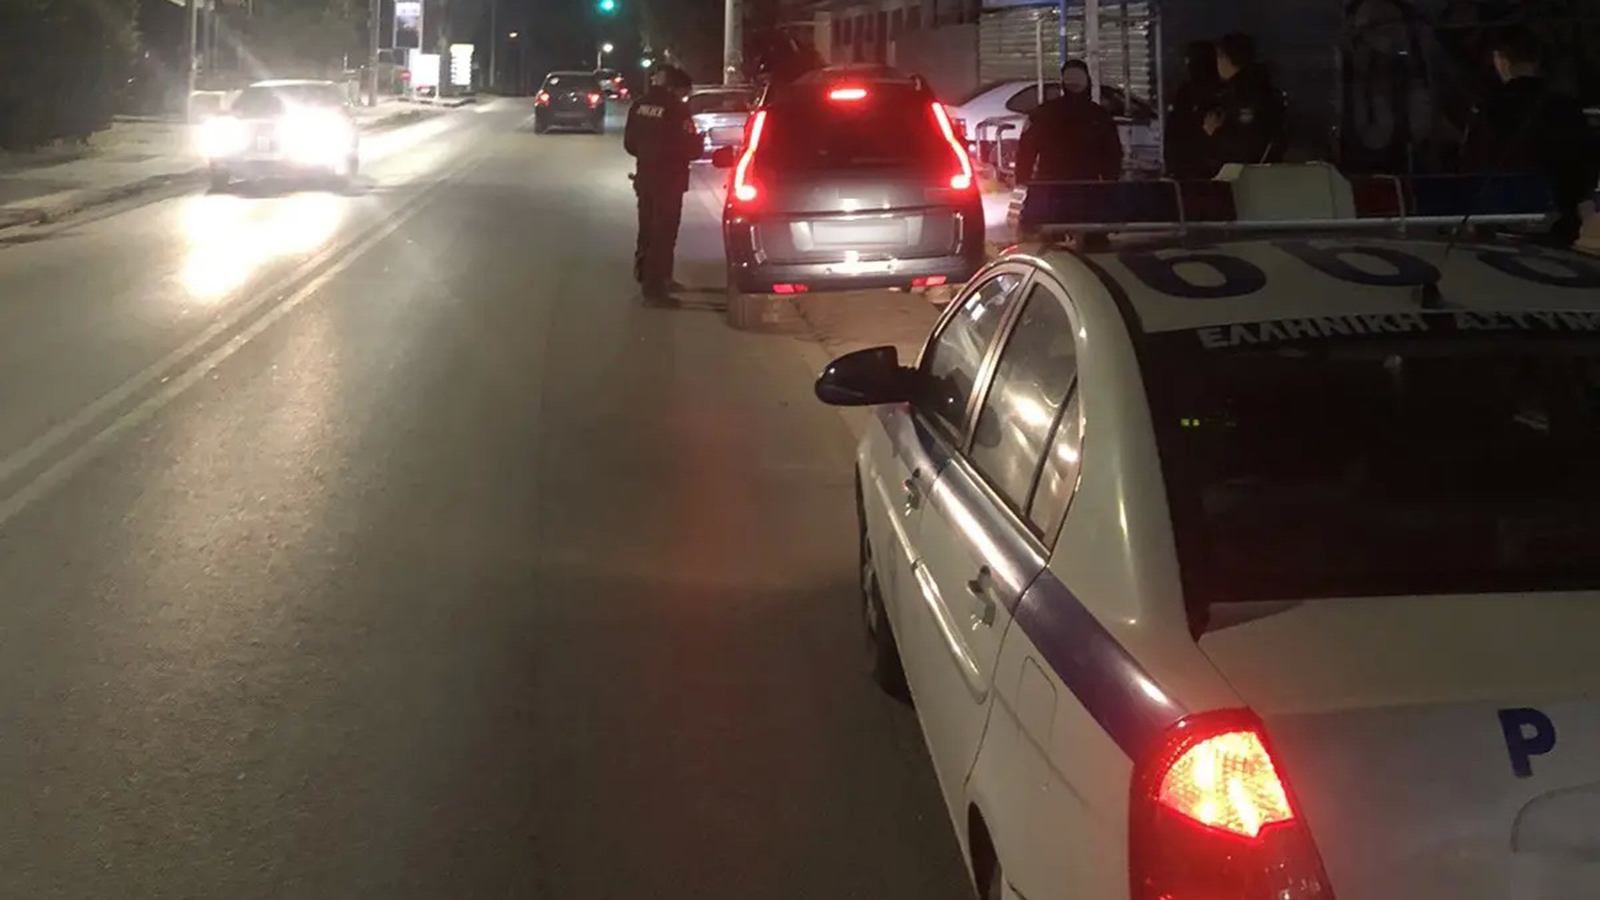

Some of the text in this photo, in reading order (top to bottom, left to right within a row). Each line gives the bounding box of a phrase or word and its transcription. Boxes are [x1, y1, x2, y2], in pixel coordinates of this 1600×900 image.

[636, 104, 665, 118] POLICE
[1197, 312, 1430, 349] ΕΛΛΗΝΙΚΗ
[1498, 707, 1556, 779] P
